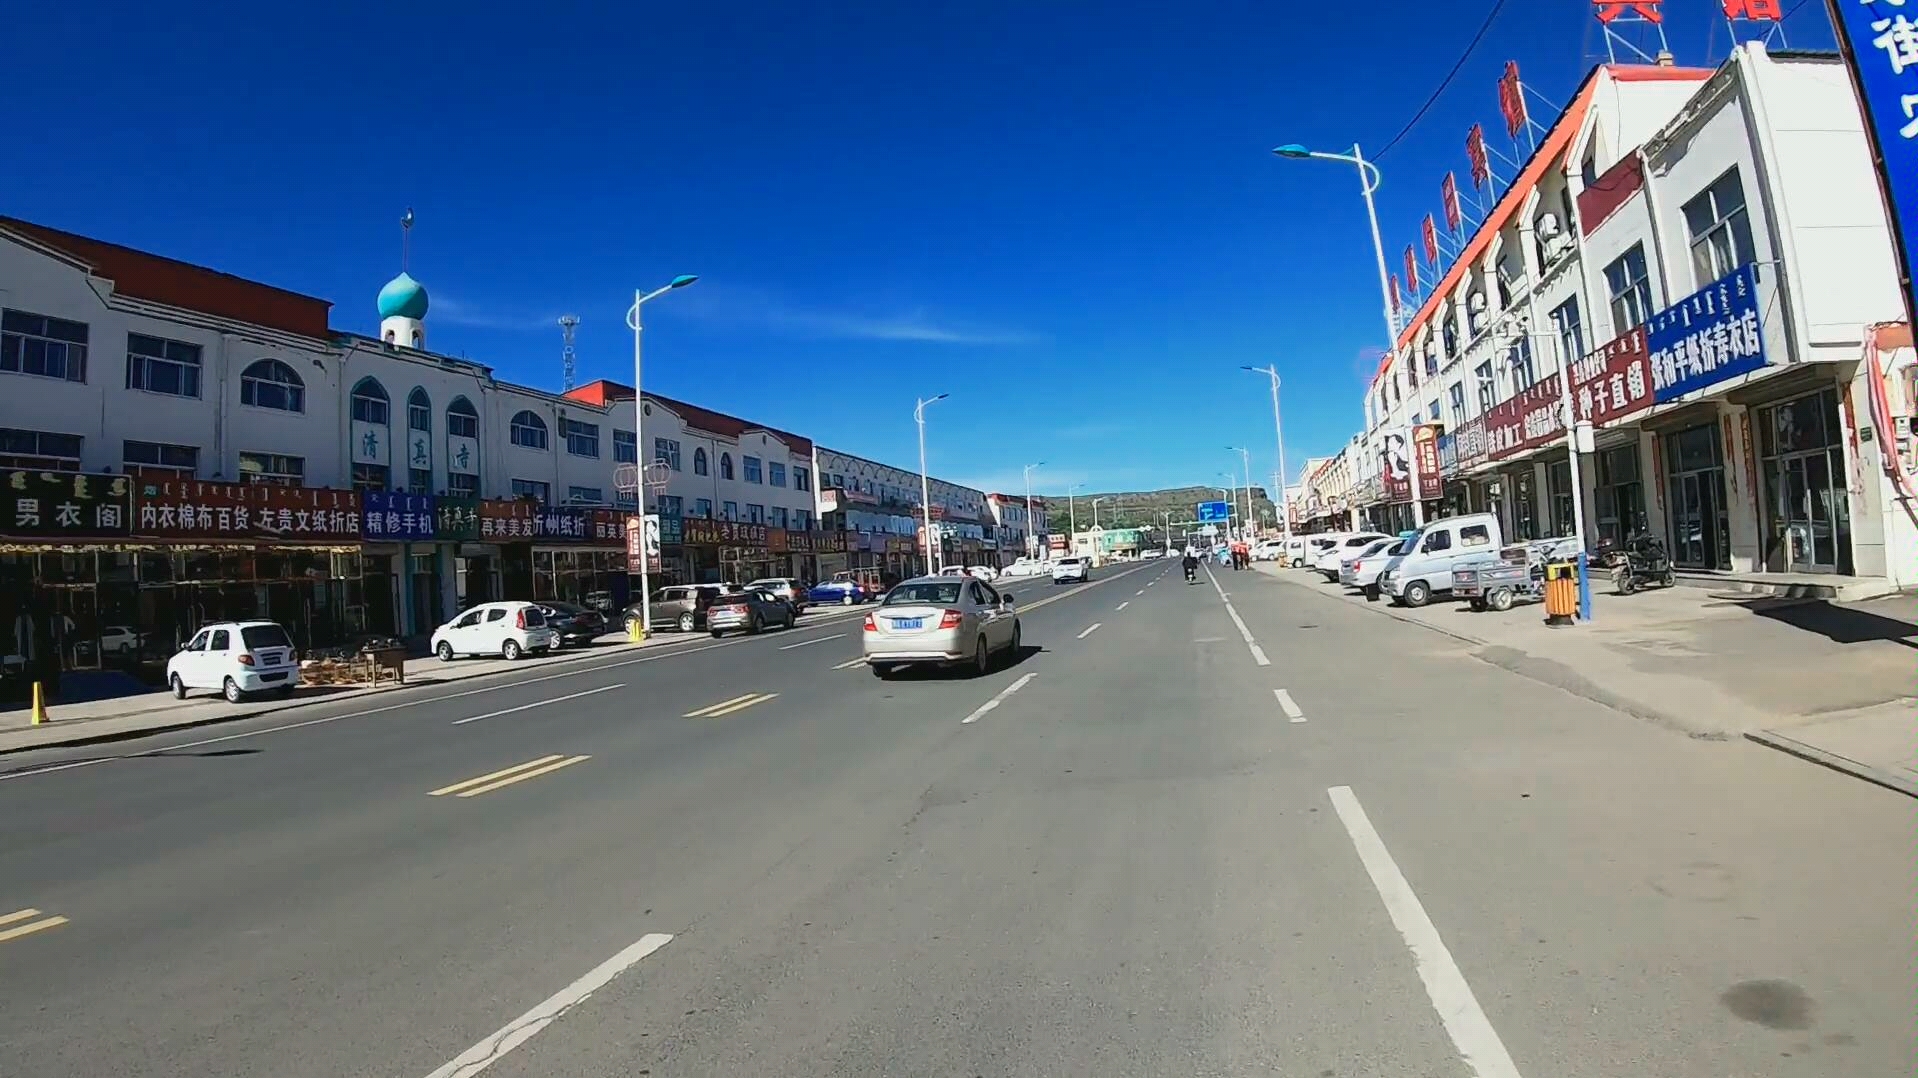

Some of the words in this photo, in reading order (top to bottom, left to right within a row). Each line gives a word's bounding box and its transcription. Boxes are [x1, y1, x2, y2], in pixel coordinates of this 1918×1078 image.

[1578, 361, 1645, 420] 种子直销
[363, 430, 470, 469] 清真寺
[15, 498, 122, 528] 男衣阁
[141, 502, 249, 530] 内衣棉布百货
[259, 507, 359, 534] 左贵文纸折店
[366, 511, 434, 535] 精修手机
[480, 517, 533, 537] 再来美发
